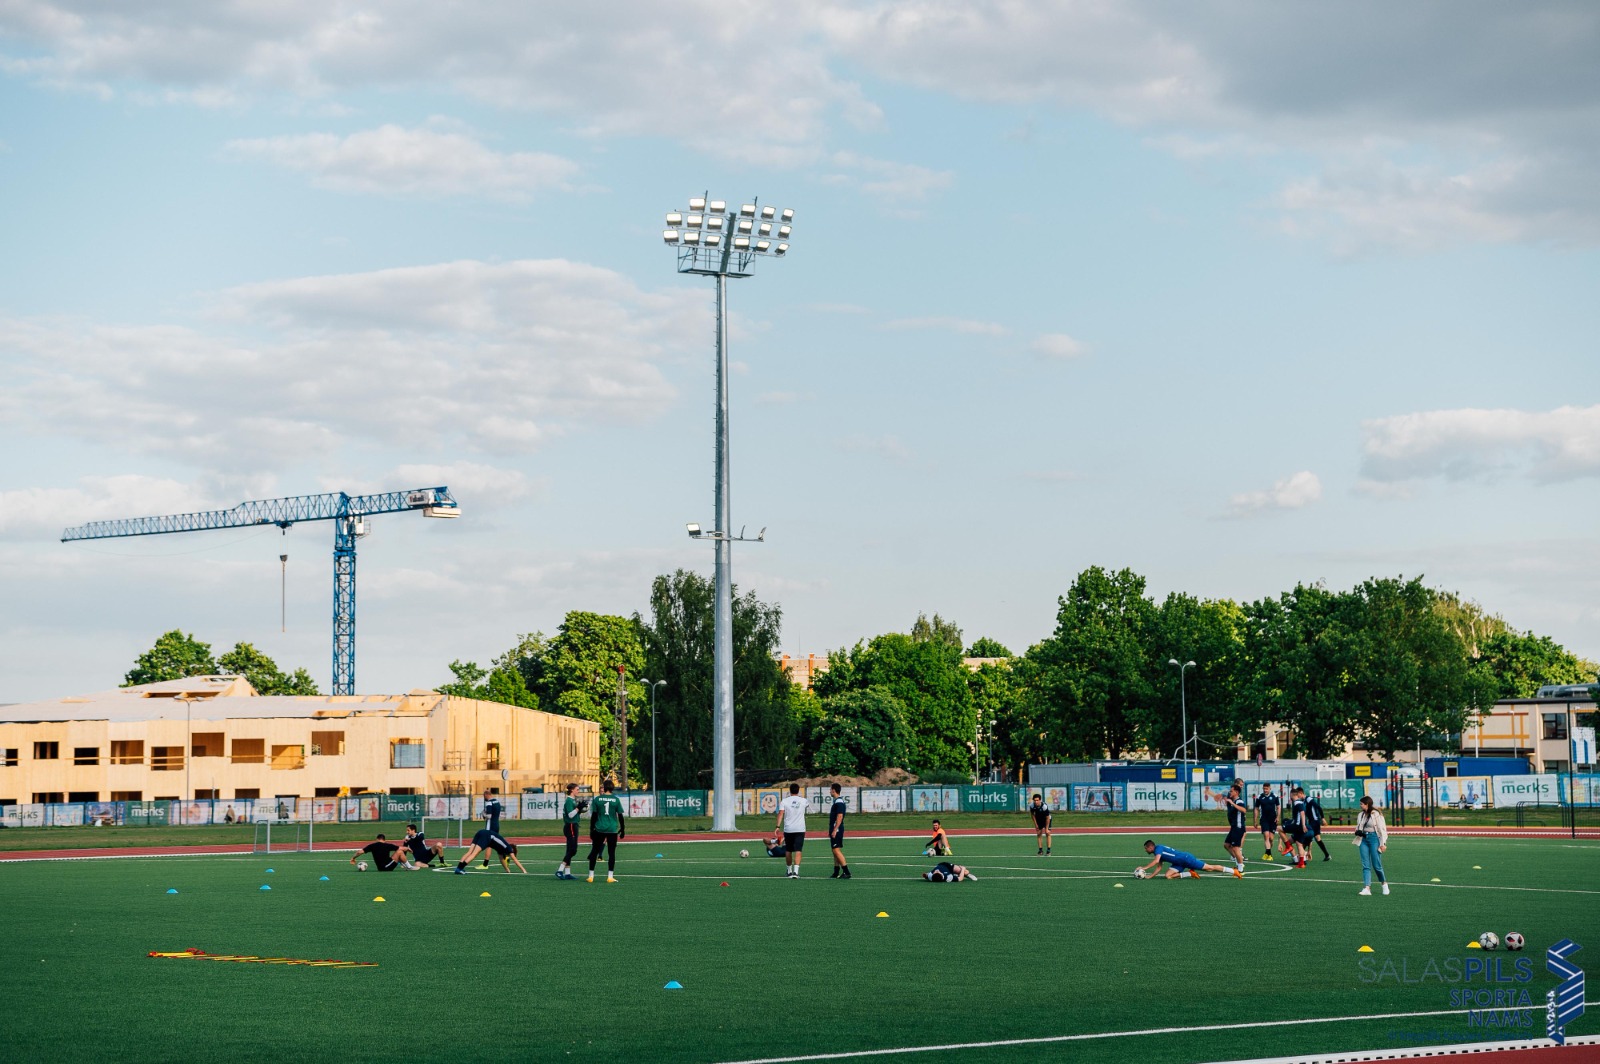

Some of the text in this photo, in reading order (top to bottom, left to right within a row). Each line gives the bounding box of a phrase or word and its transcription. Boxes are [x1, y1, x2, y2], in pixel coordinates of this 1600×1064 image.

[1309, 787, 1356, 798] merks
[1502, 782, 1549, 794] merks
[968, 792, 1008, 803] merks
[1134, 790, 1178, 801] merks
[387, 801, 420, 811] merks
[527, 800, 559, 809] merks
[666, 797, 702, 807] merks
[131, 807, 164, 817] merks
[603, 801, 610, 816] 1
